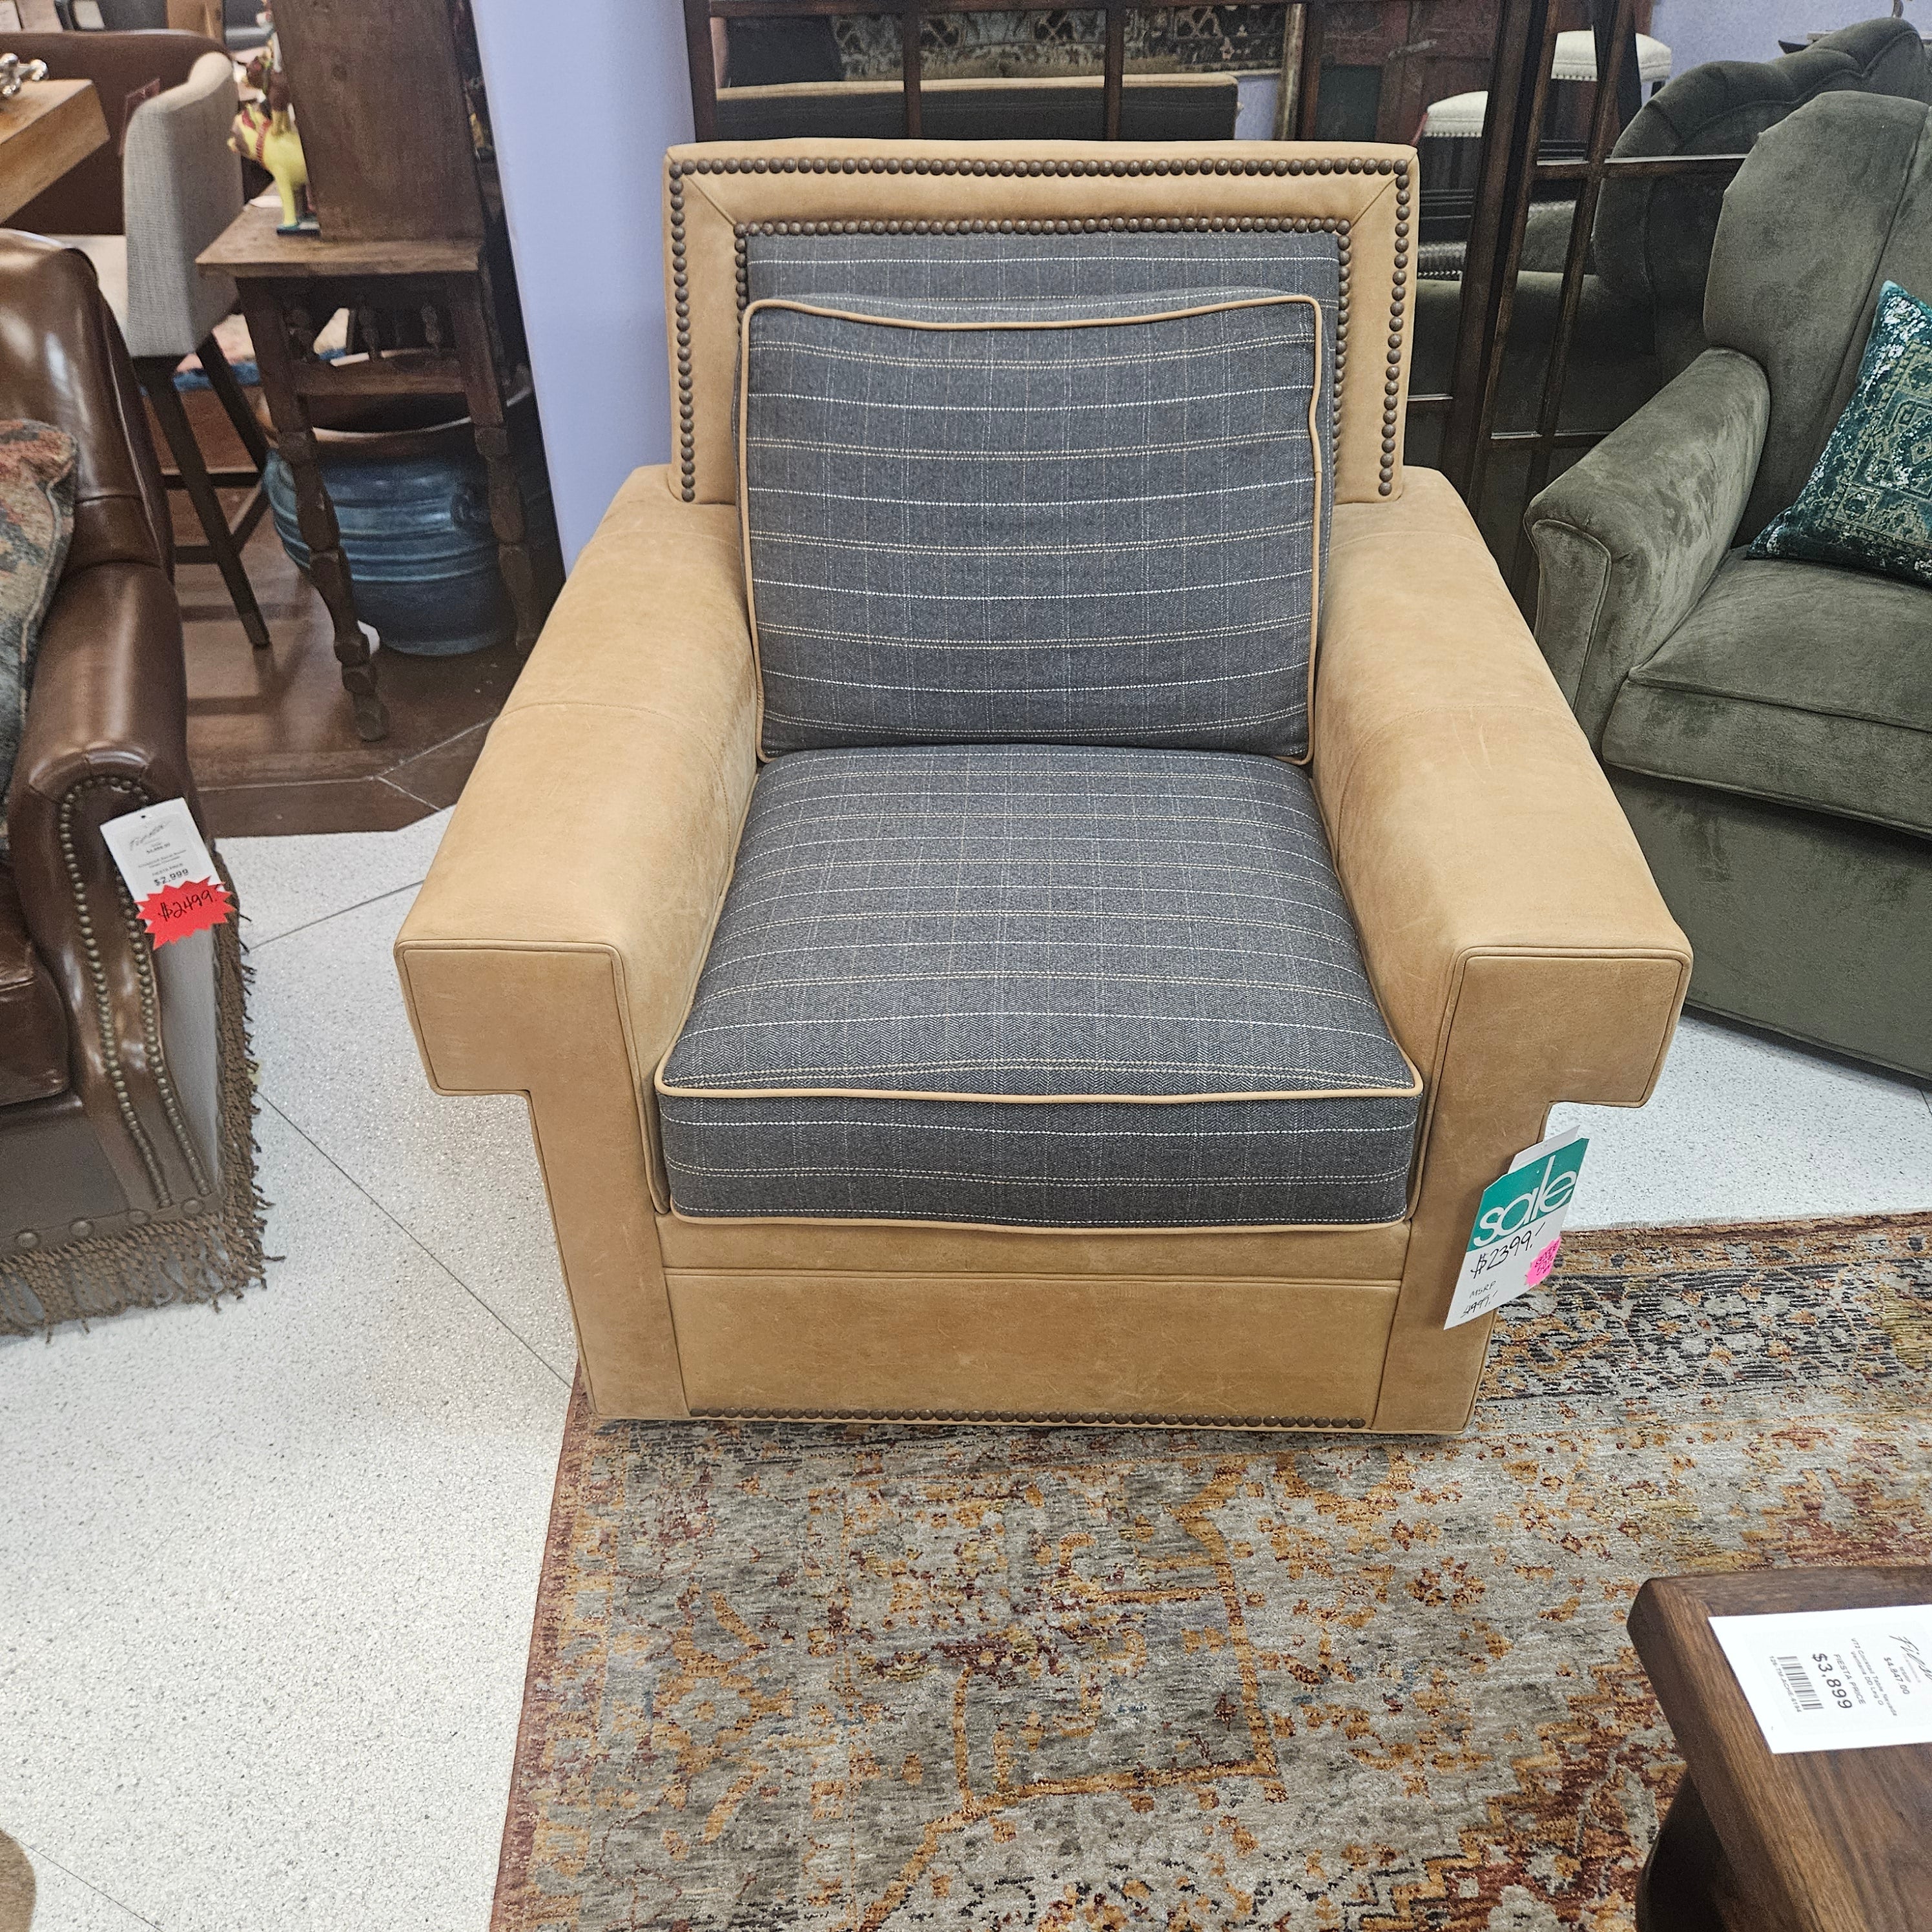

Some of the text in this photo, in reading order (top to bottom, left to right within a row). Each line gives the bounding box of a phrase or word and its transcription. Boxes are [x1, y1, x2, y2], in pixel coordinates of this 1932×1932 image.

[1474, 1155, 1577, 1246] sale
[1469, 1280, 1496, 1299] MSRP
[1812, 1653, 1853, 1709] $3,899
[1833, 1654, 1866, 1705] FIESTA PRICE
